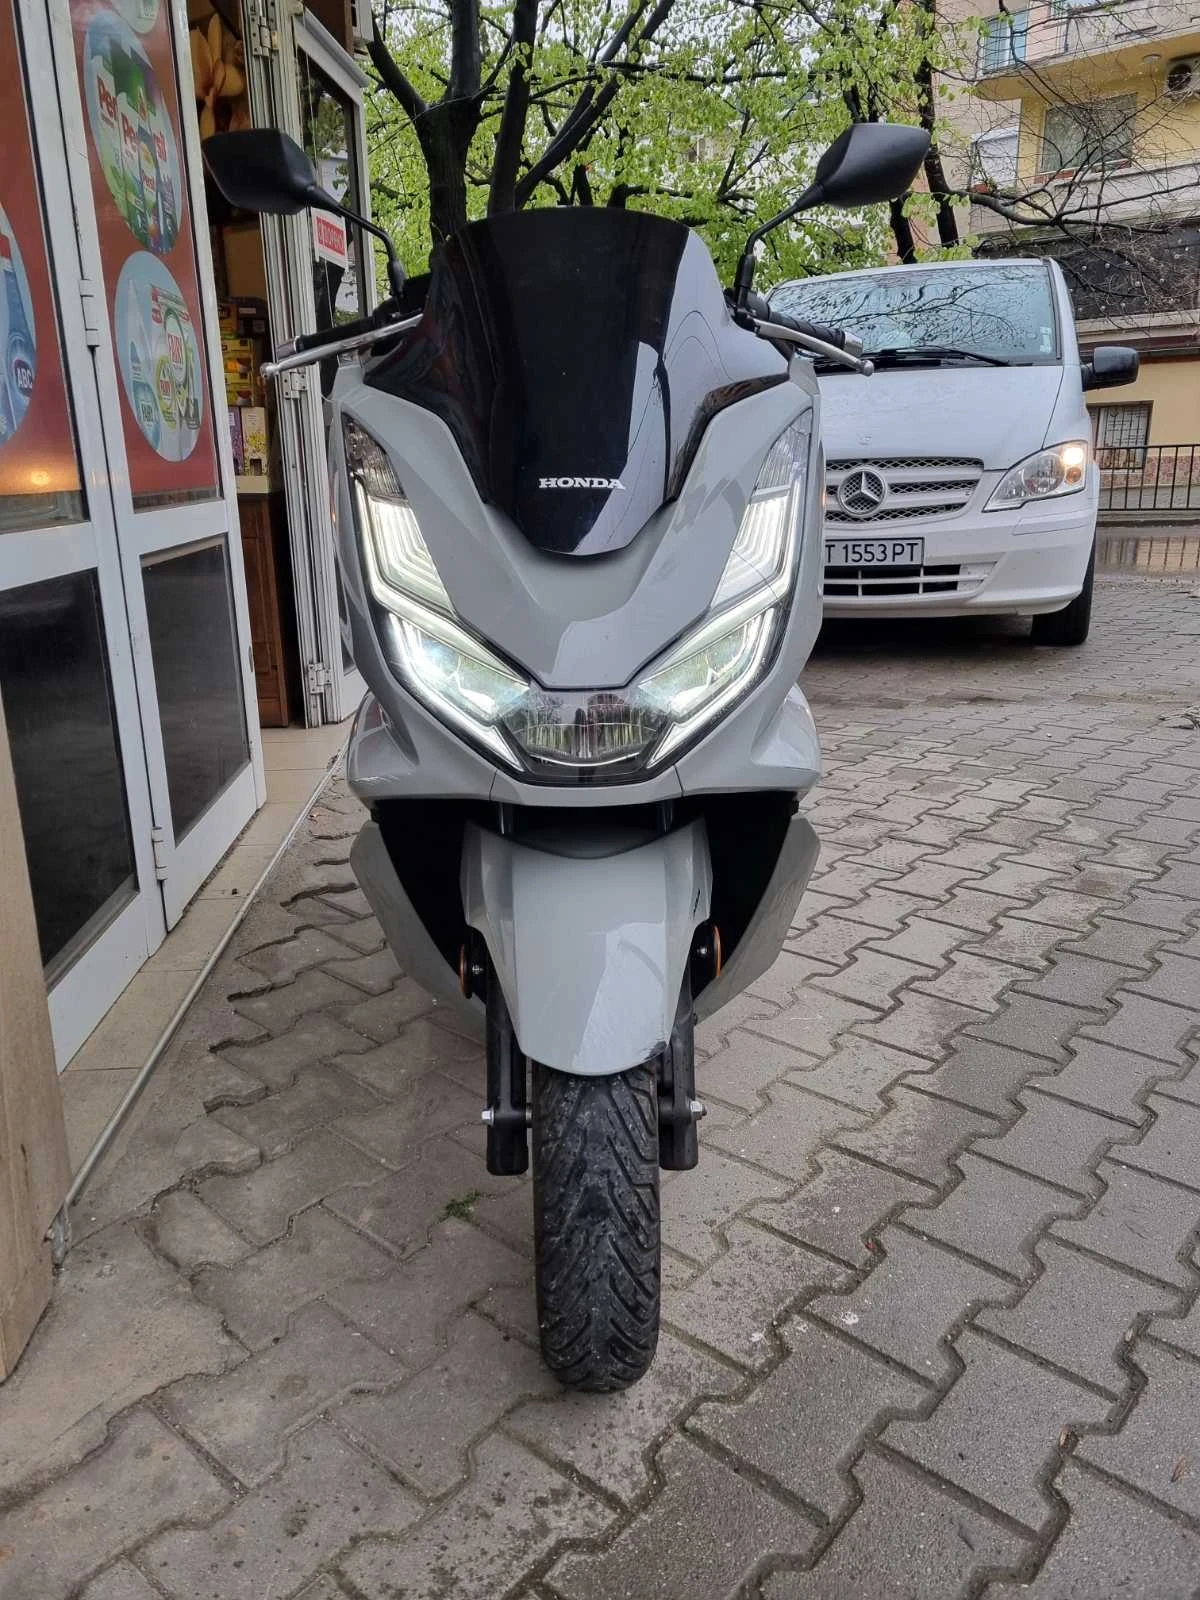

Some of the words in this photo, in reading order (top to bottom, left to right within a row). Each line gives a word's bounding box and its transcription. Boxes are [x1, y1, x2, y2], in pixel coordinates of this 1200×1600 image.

[538, 477, 626, 490] HONDA
[842, 543, 888, 563] 1553
[892, 542, 919, 562] PT
